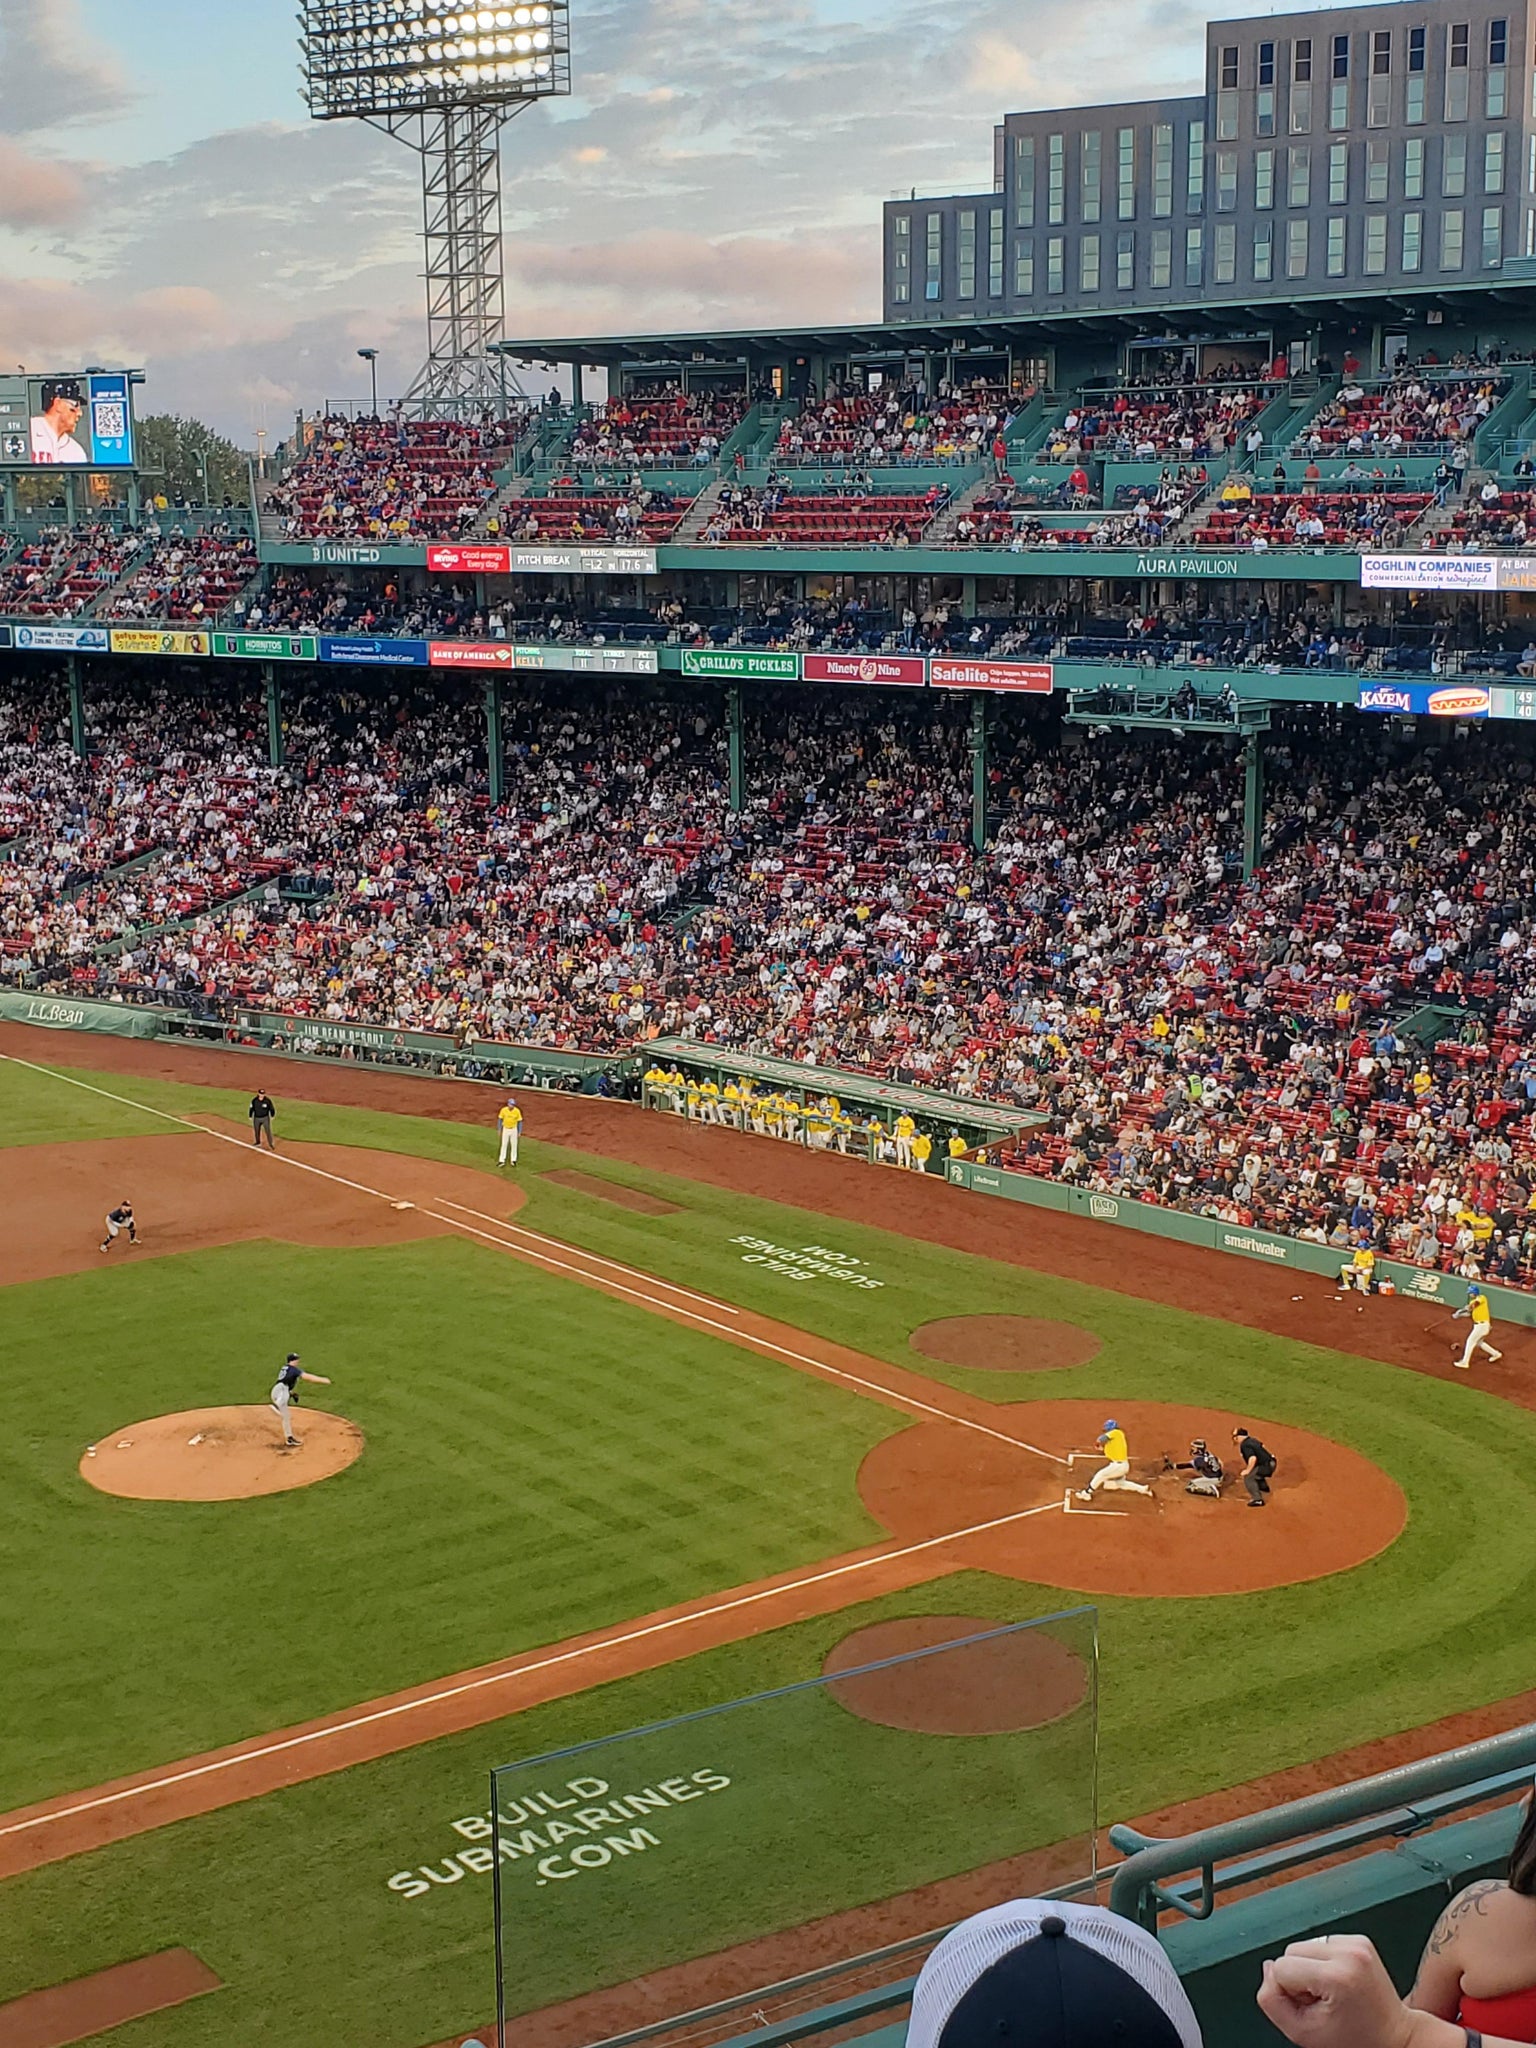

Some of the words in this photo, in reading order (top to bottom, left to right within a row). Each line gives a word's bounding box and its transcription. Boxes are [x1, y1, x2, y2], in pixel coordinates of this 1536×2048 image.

[327, 548, 380, 562] UNITED
[517, 554, 541, 565] PITCH
[542, 555, 570, 565] BREAK
[622, 560, 640, 570] 17.6
[1180, 559, 1237, 574] PAVILION
[1365, 560, 1416, 571] COGHLIN
[1418, 561, 1492, 573] COMPANIES
[1501, 560, 1512, 568] AT
[1514, 560, 1530, 569] BAT
[245, 639, 282, 650] HORNITOS
[433, 650, 453, 659] BANK
[453, 651, 462, 659] OF
[463, 651, 496, 660] AMERICA
[516, 656, 544, 668] KELLY
[611, 659, 617, 669] 7
[638, 660, 650, 670] 64
[700, 656, 744, 670] GRILLO'S
[748, 659, 794, 673] PICKLES
[827, 661, 859, 676] Ninety
[878, 664, 901, 676] Nine
[932, 666, 989, 682] Safelite
[1360, 691, 1410, 711] KAYEM
[1518, 691, 1532, 703] 49
[1518, 705, 1532, 717] 40
[28, 1002, 84, 1024] L.L.Bean
[1224, 1234, 1287, 1259] smartwater
[728, 1235, 885, 1290] SUBMARINES
[741, 1254, 817, 1281] BUILD
[1402, 1288, 1416, 1297] new
[1416, 1290, 1445, 1304] balance
[450, 1776, 610, 1840] BUILD
[387, 1768, 732, 1899] SUBMARINES
[535, 1826, 662, 1887] .COM
